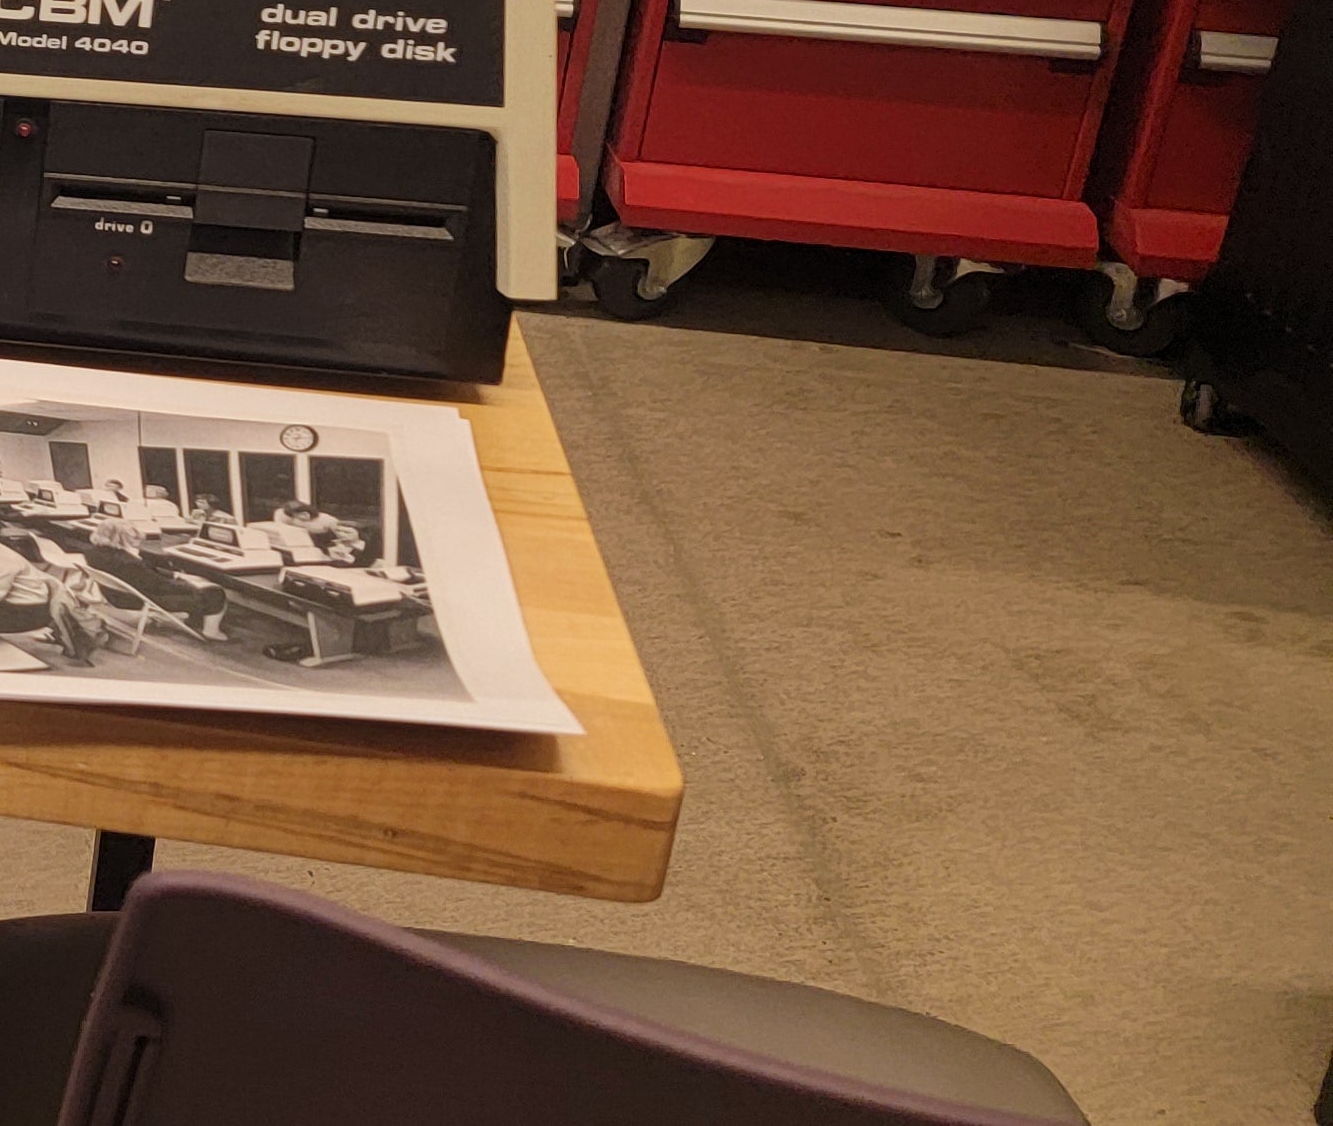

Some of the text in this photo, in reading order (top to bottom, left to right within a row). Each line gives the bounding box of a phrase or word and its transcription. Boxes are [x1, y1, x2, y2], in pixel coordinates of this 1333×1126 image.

[261, 3, 448, 34] dual drive
[74, 36, 150, 55] 4040
[255, 30, 459, 64] floppy disk
[94, 217, 134, 234] drive
